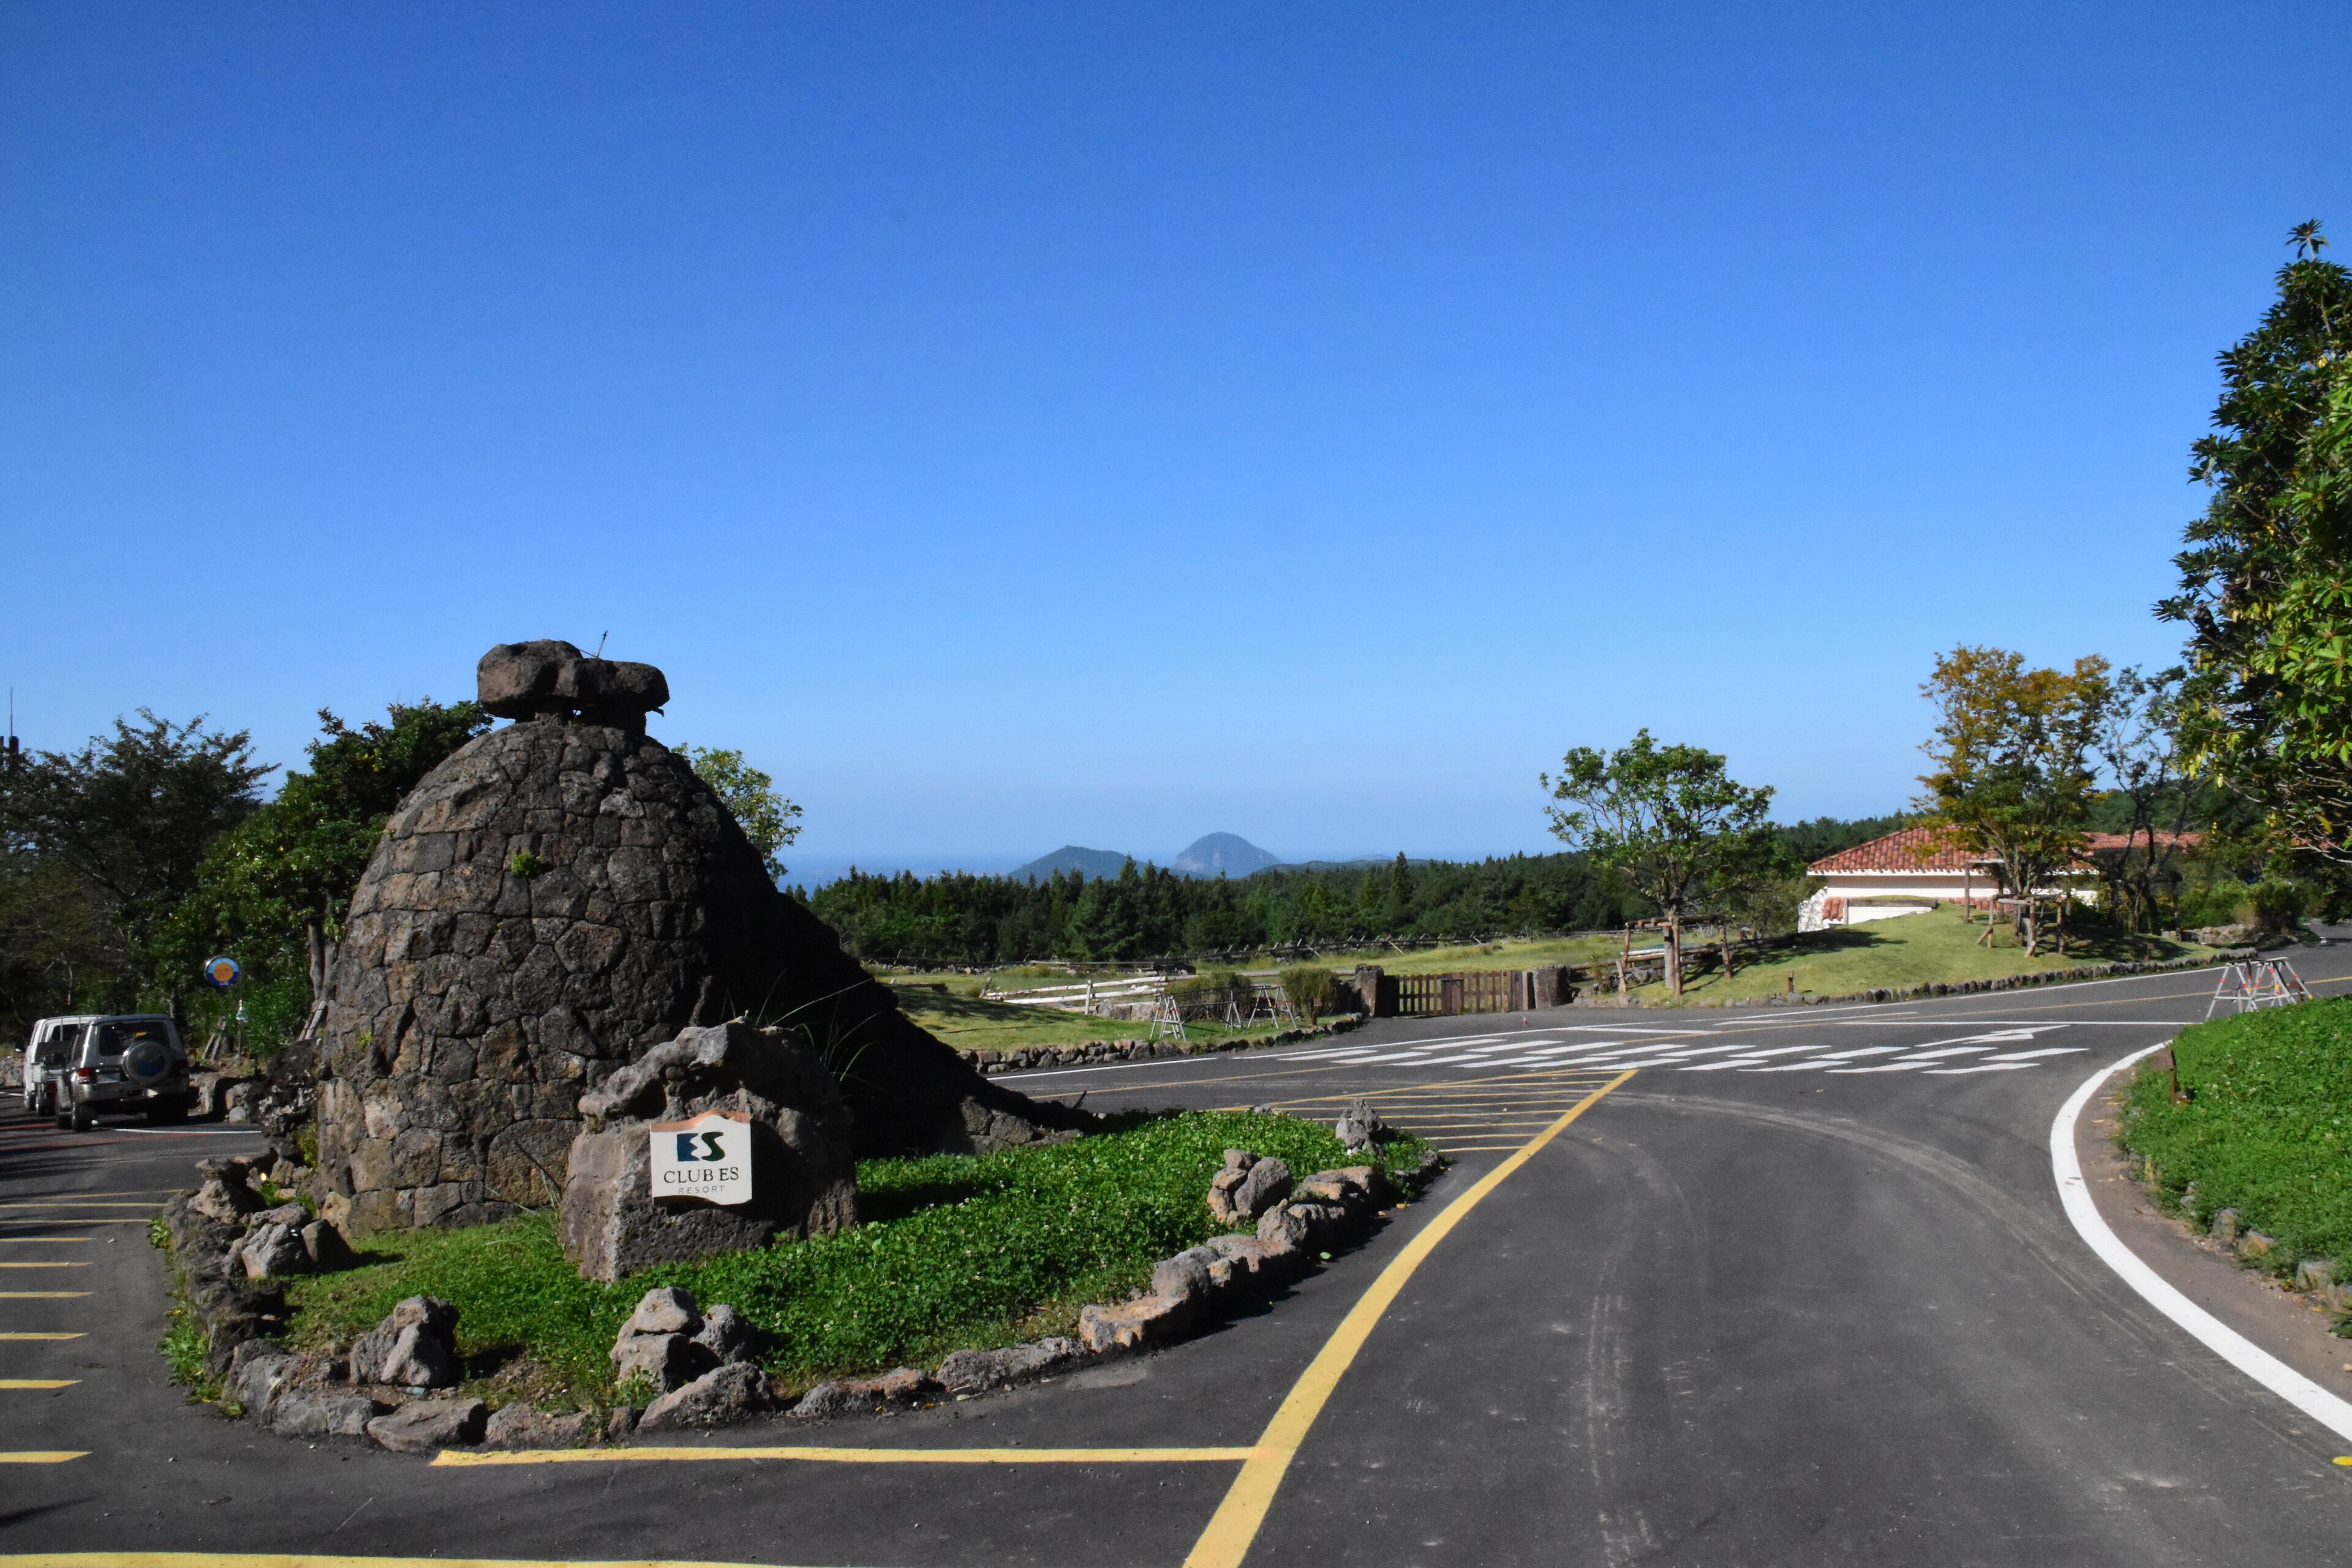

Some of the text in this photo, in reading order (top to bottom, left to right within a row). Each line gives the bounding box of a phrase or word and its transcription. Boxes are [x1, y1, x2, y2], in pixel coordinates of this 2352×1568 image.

[664, 1167, 739, 1183] CLUB ES
[679, 1185, 725, 1194] RESORT
